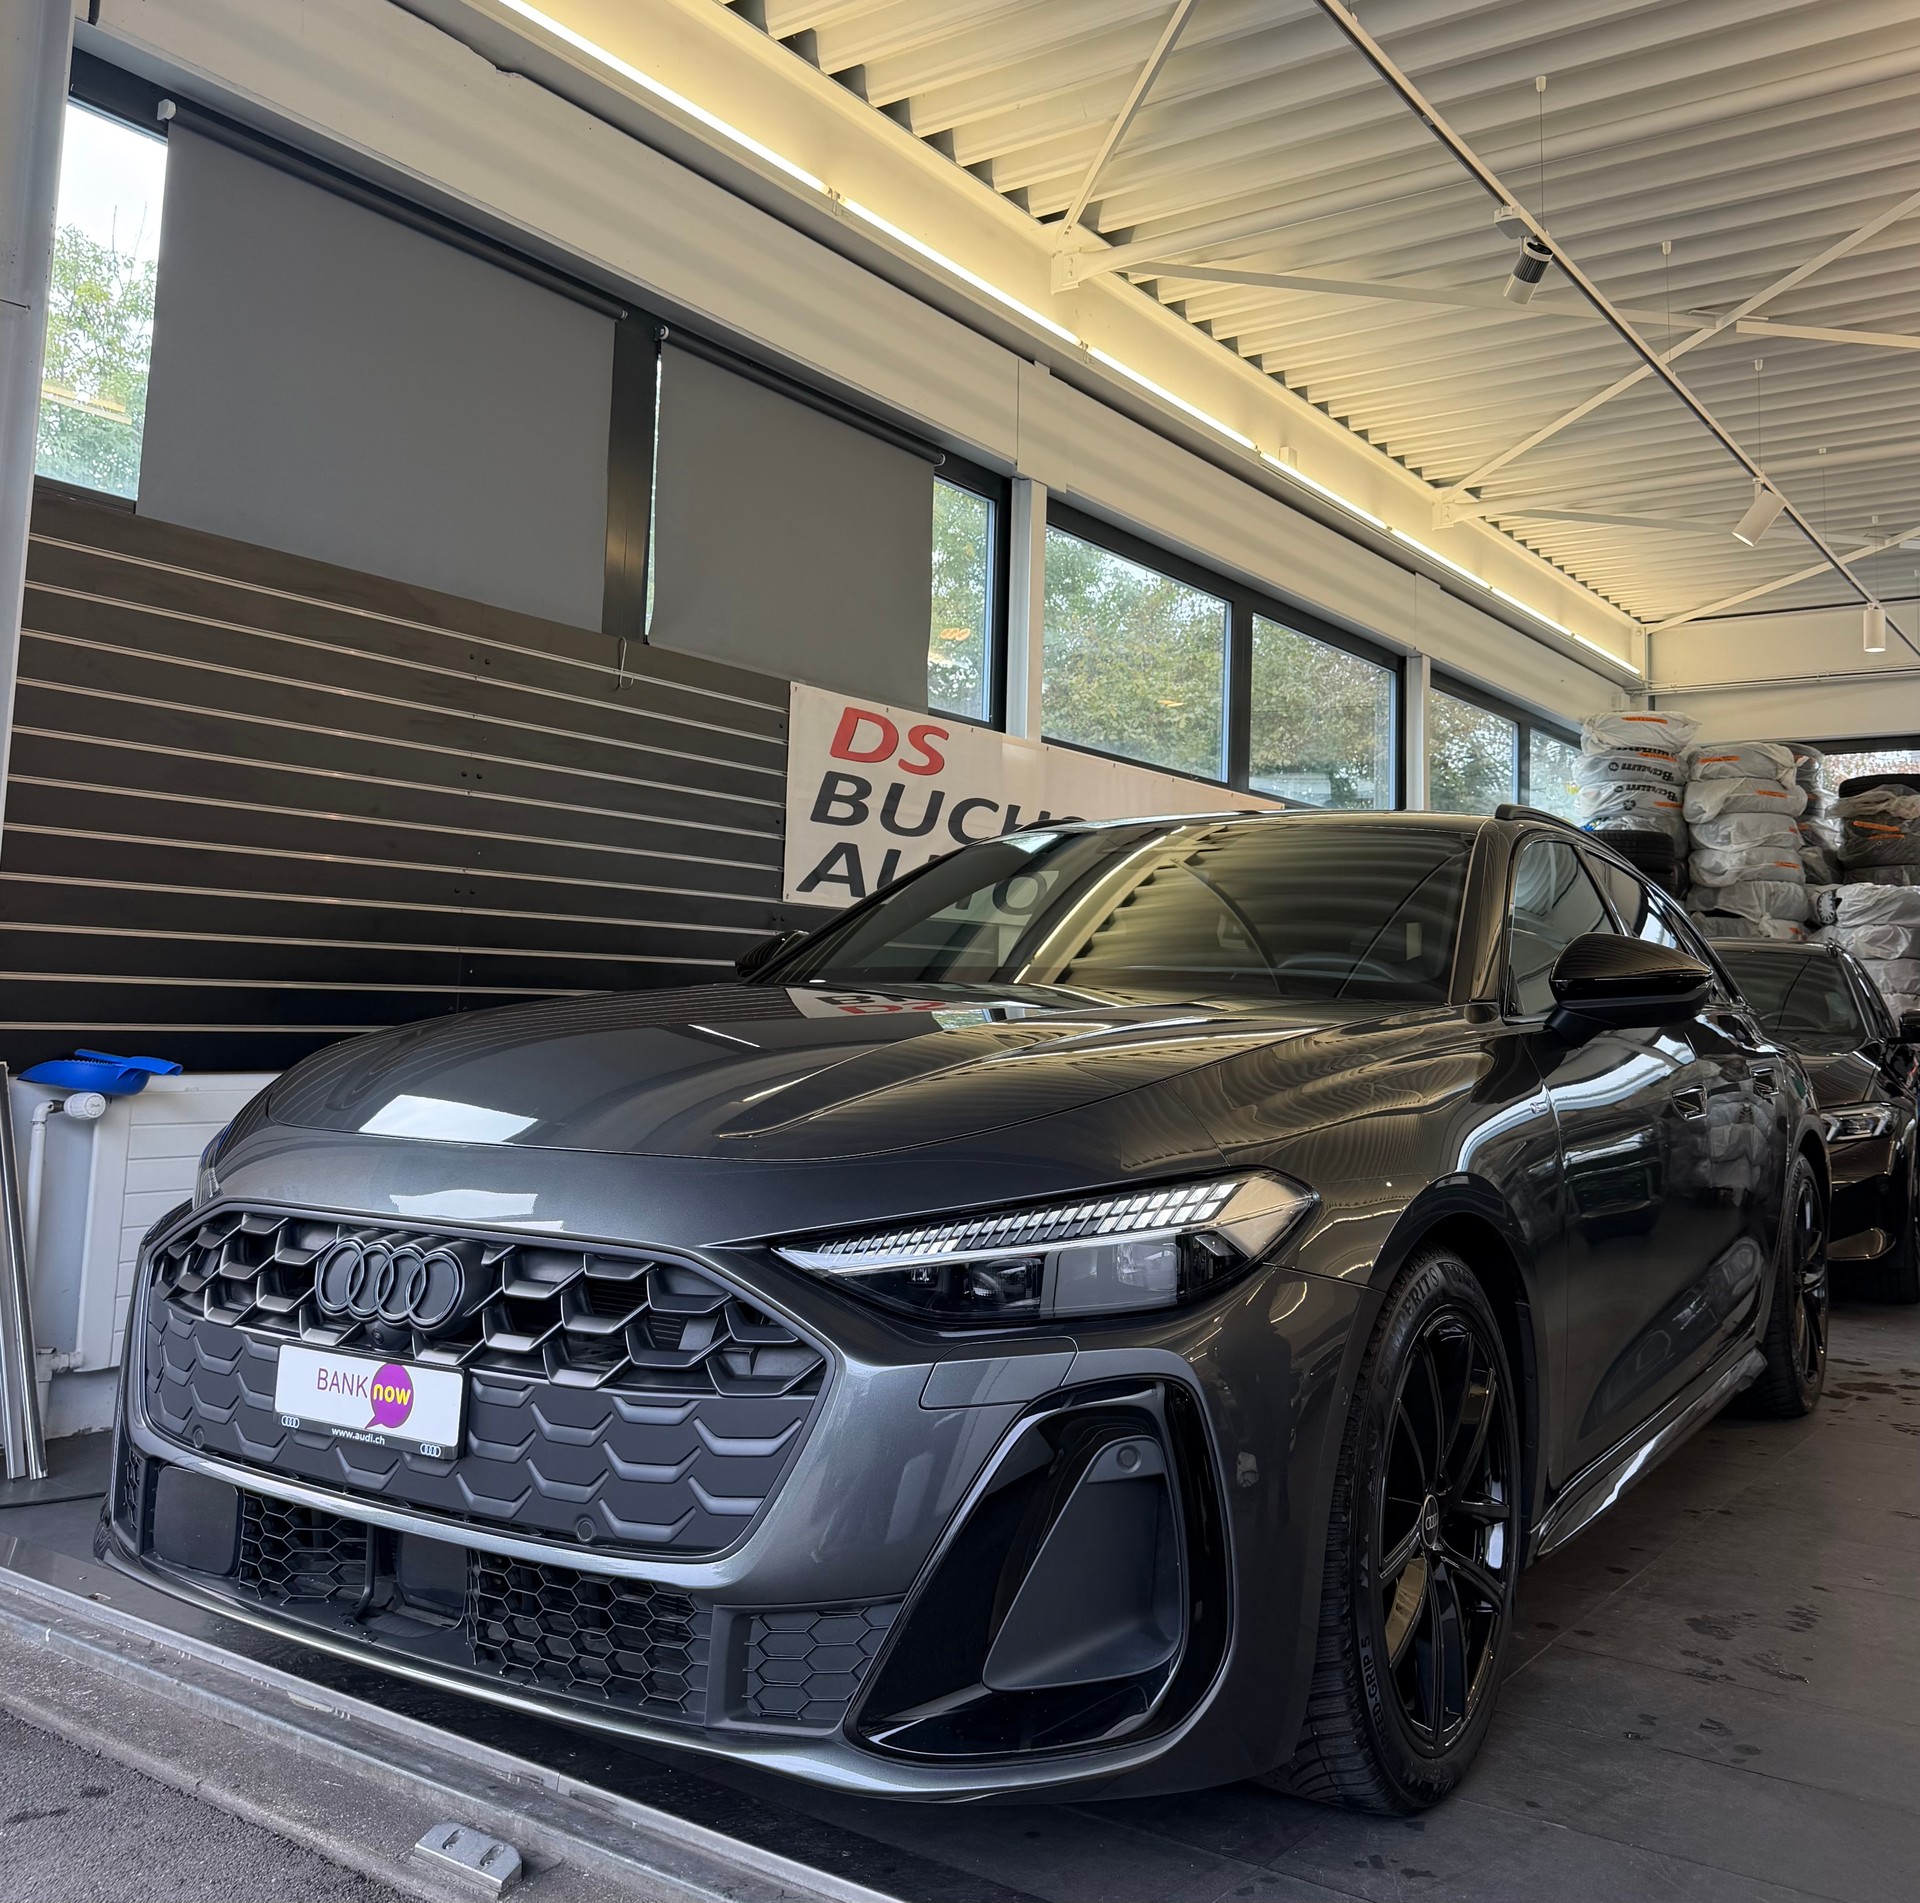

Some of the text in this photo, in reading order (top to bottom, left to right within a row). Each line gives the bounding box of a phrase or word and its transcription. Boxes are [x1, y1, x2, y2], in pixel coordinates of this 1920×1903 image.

[830, 706, 949, 776] DS
[810, 770, 1087, 845] BUCH
[317, 1367, 412, 1406] BANK now
[331, 1426, 386, 1446] www.audi.ch
[1360, 1635, 1371, 1648] 5
